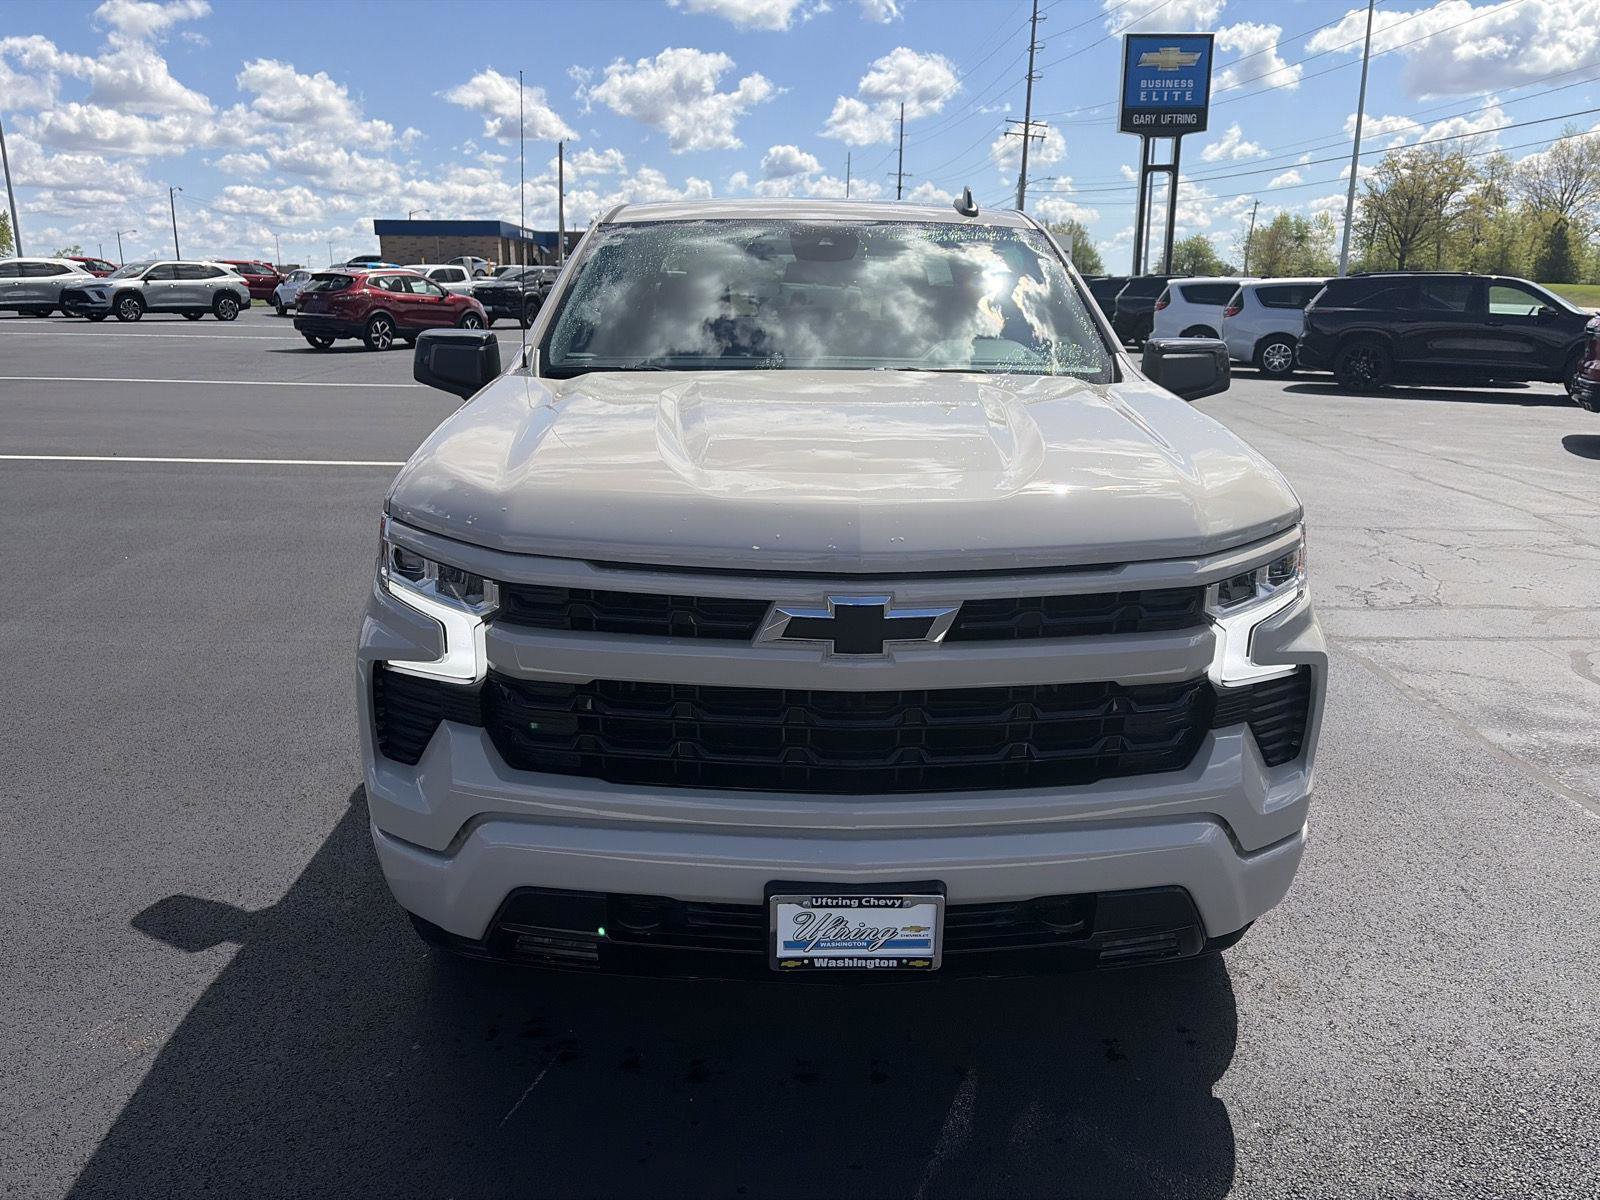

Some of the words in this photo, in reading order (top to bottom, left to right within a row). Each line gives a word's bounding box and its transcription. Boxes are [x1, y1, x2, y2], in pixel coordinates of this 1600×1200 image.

[1140, 79, 1194, 88] BUSINESS
[1140, 91, 1192, 101] ELITE
[1132, 114, 1157, 125] GARY
[1160, 113, 1197, 125] UFTRING
[812, 897, 859, 907] Uftring
[861, 897, 902, 907] Chevy
[792, 911, 899, 953] Uftring
[813, 958, 898, 969] Washington
